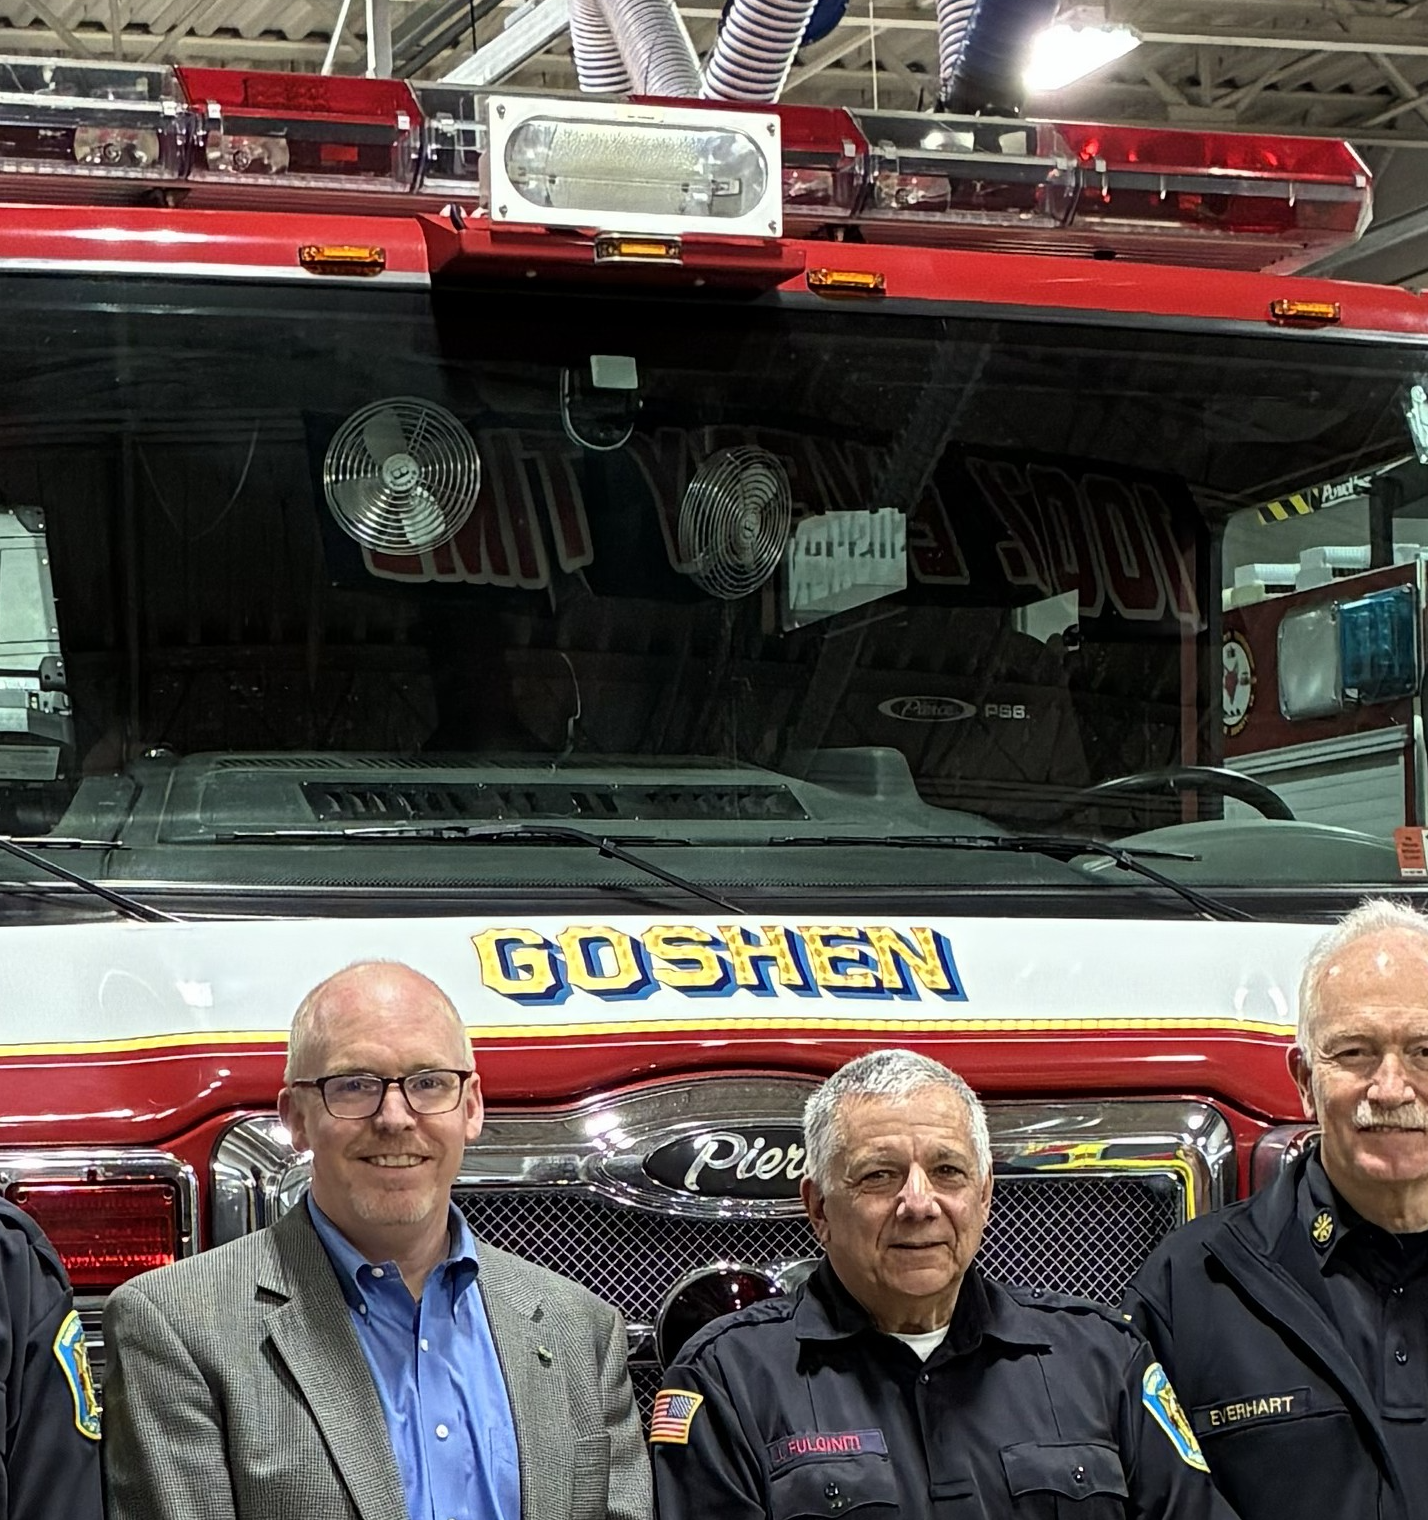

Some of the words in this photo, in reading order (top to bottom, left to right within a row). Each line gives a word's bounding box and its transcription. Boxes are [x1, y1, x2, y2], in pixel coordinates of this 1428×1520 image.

[471, 925, 969, 1005] GOSHEN
[684, 1131, 808, 1191] Pier
[1210, 1396, 1294, 1426] EVERHART
